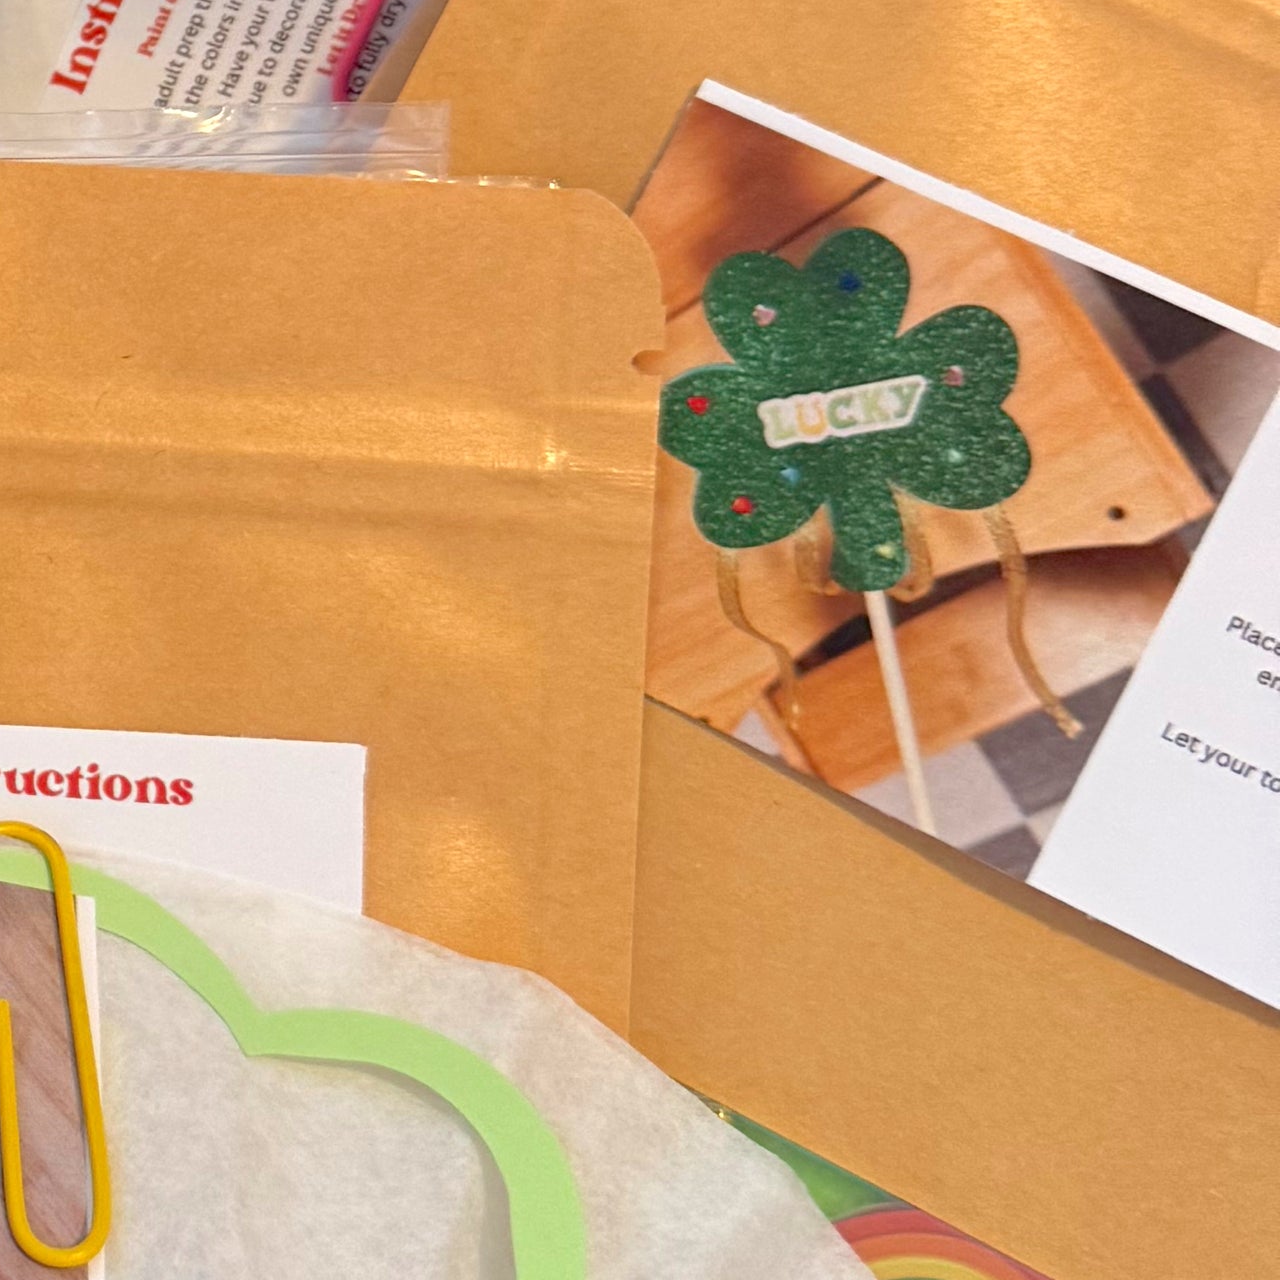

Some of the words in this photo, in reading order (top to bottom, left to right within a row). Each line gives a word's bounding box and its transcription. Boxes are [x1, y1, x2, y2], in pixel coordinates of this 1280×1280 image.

[136, 6, 173, 58] Paint
[174, 13, 206, 60] prep
[216, 49, 251, 98] Have
[240, 4, 270, 50] your
[281, 57, 309, 98] own
[762, 378, 924, 442] LUCKY
[1160, 721, 1202, 754] Let
[1198, 744, 1258, 779] your
